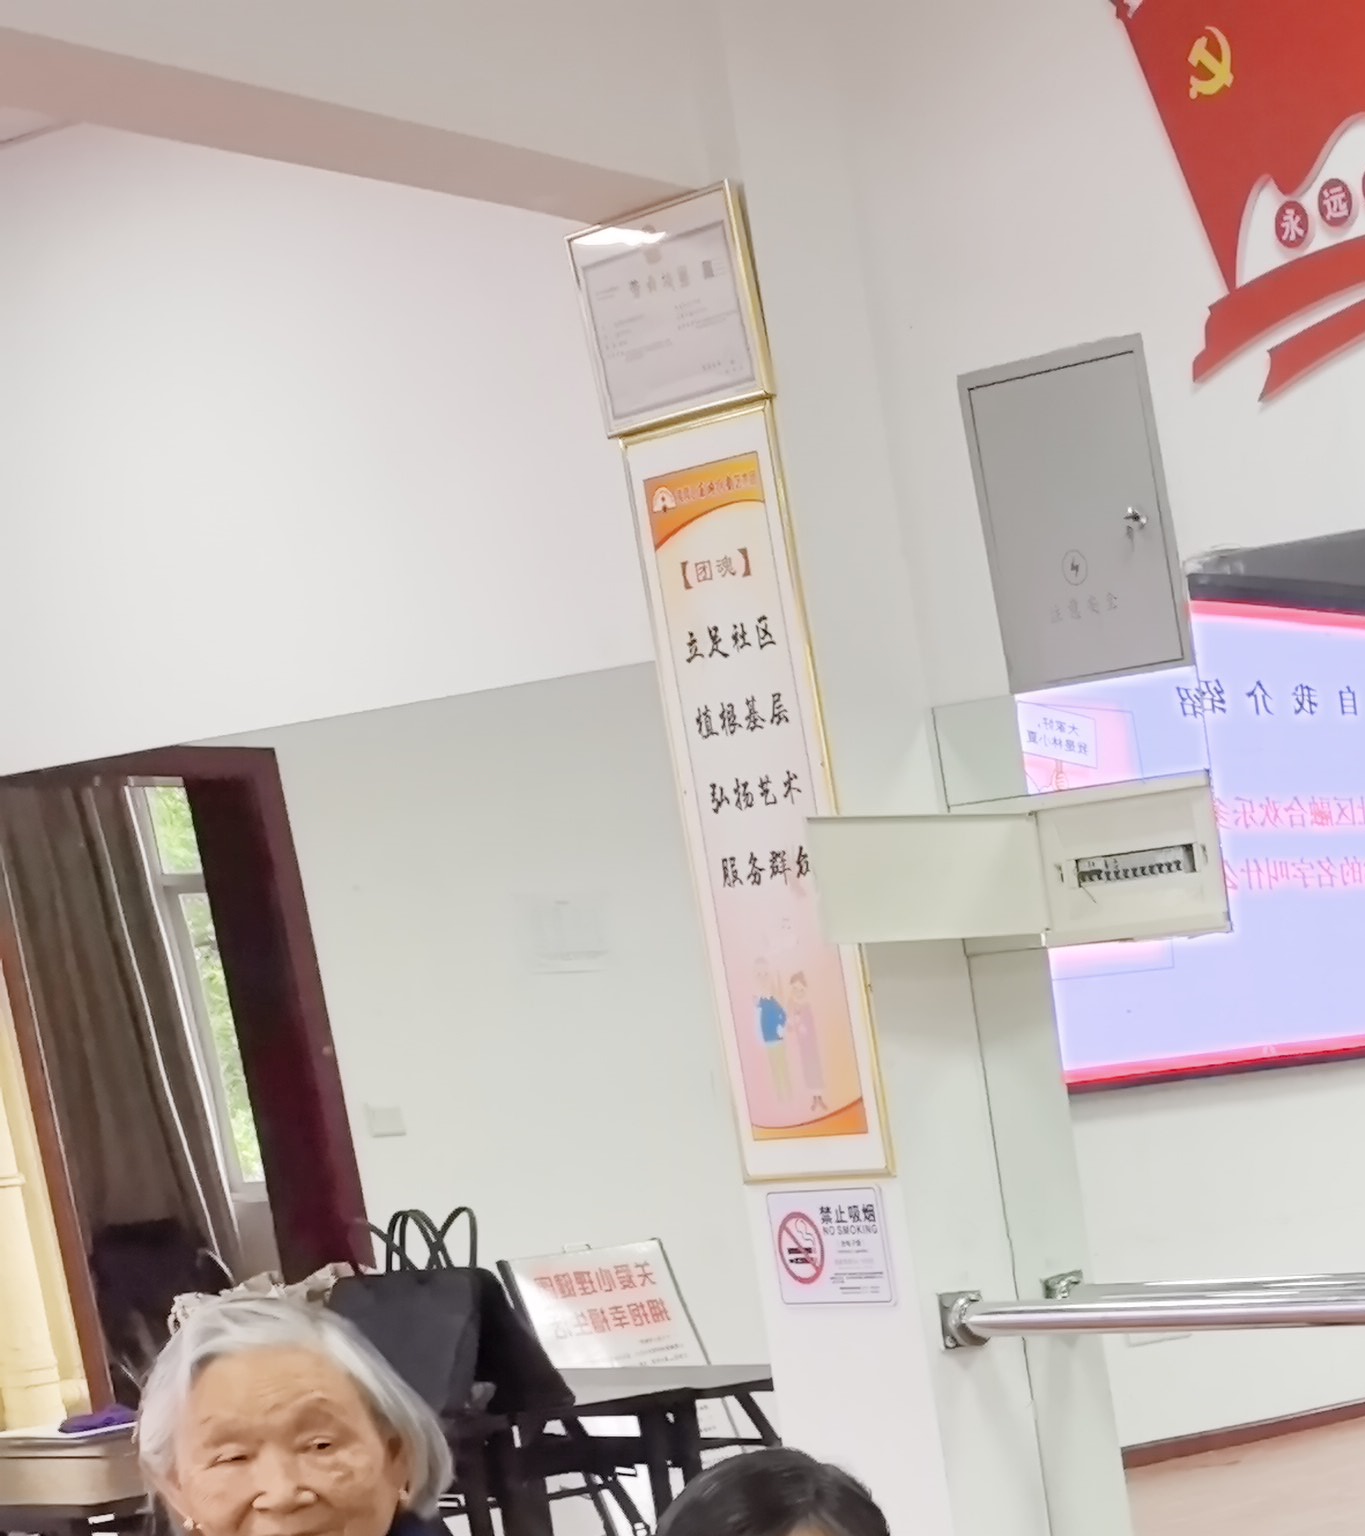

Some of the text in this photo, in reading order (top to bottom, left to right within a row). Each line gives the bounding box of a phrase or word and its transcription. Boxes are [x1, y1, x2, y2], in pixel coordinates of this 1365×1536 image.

[686, 615, 776, 664] 立足社区
[696, 693, 789, 739] 植根基层
[710, 770, 801, 814] 弘扬艺术
[819, 1204, 876, 1225] 禁止吸烟
[823, 1224, 879, 1236] NO SMOKING
